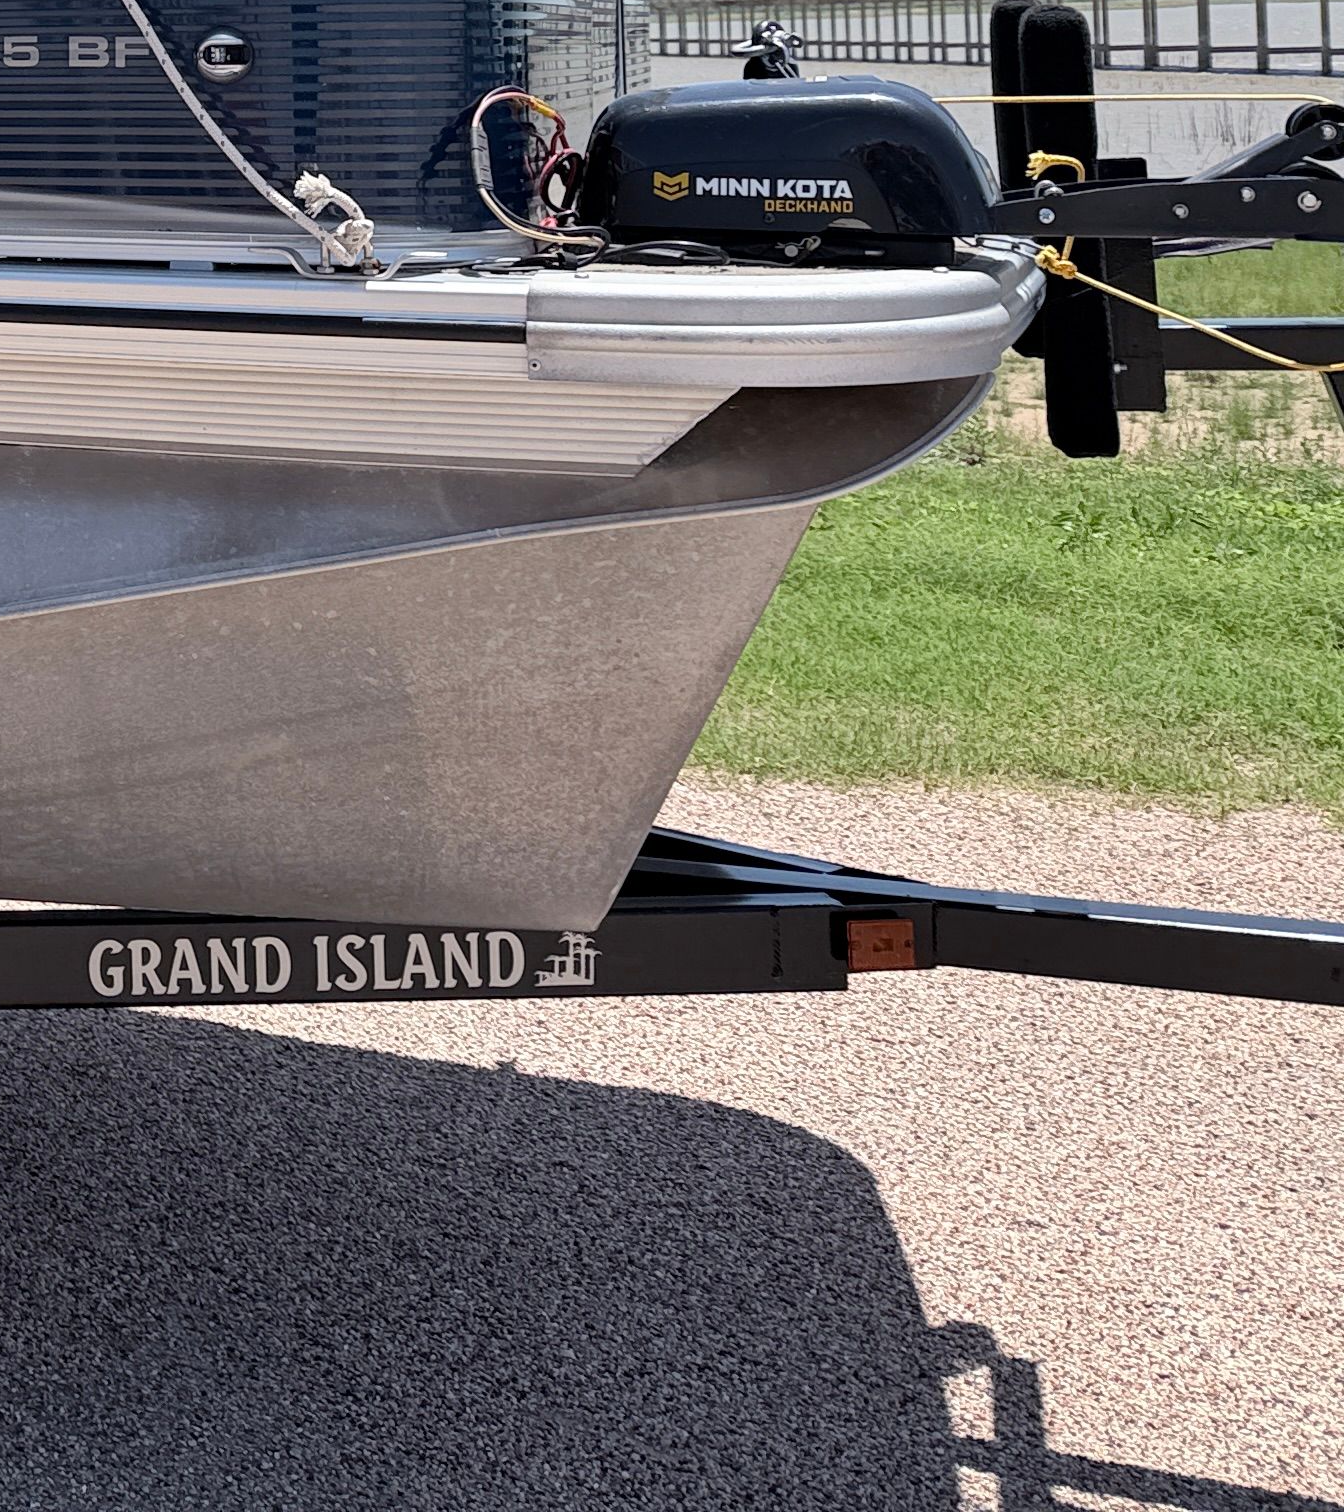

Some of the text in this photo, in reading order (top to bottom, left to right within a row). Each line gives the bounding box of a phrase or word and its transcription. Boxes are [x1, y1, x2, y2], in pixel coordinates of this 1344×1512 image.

[67, 35, 153, 69] BF
[695, 177, 855, 199] MINN KOTA
[764, 199, 854, 214] DECKHAND
[86, 931, 527, 997] GRAND ISLAND
